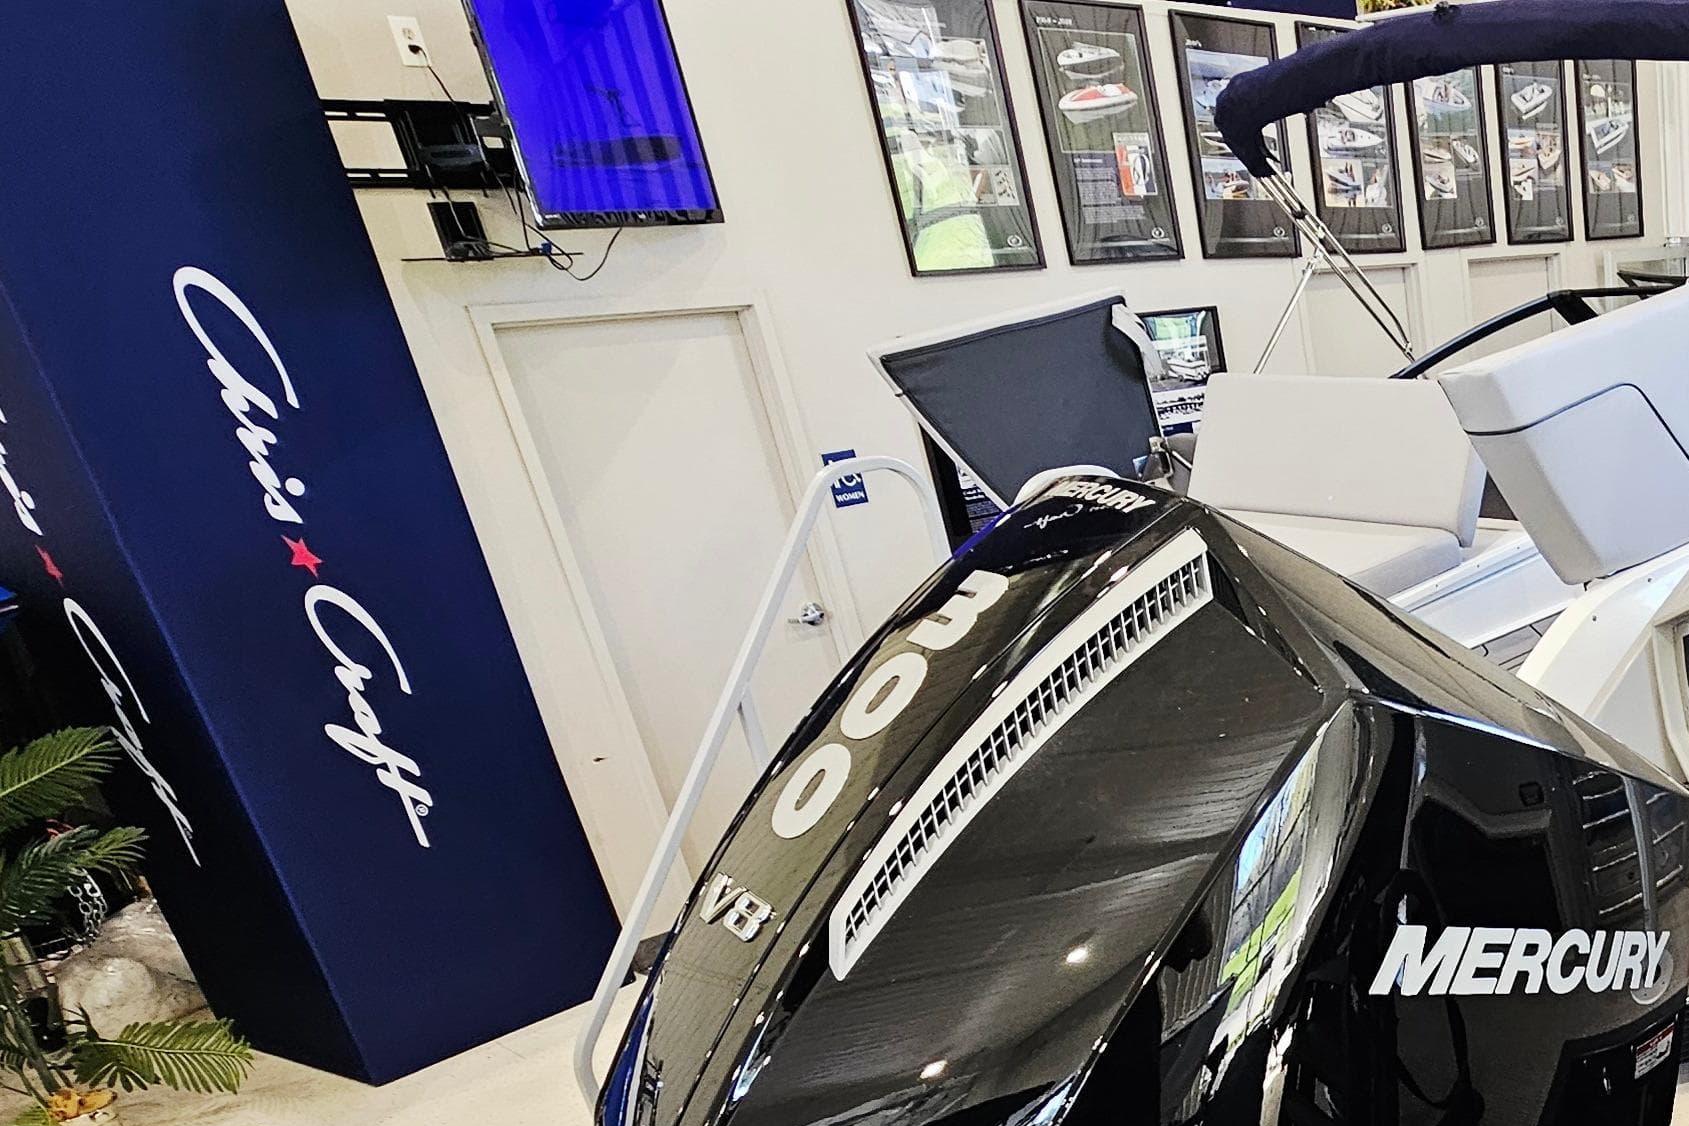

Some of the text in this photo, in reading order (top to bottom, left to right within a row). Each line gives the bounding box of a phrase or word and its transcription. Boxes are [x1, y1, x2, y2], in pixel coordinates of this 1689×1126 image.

[835, 491, 865, 502] WOMEN
[173, 265, 433, 848] Chris Craft
[771, 569, 1010, 840] 300
[699, 872, 777, 942] V8
[1368, 925, 1670, 996] MERCURY
